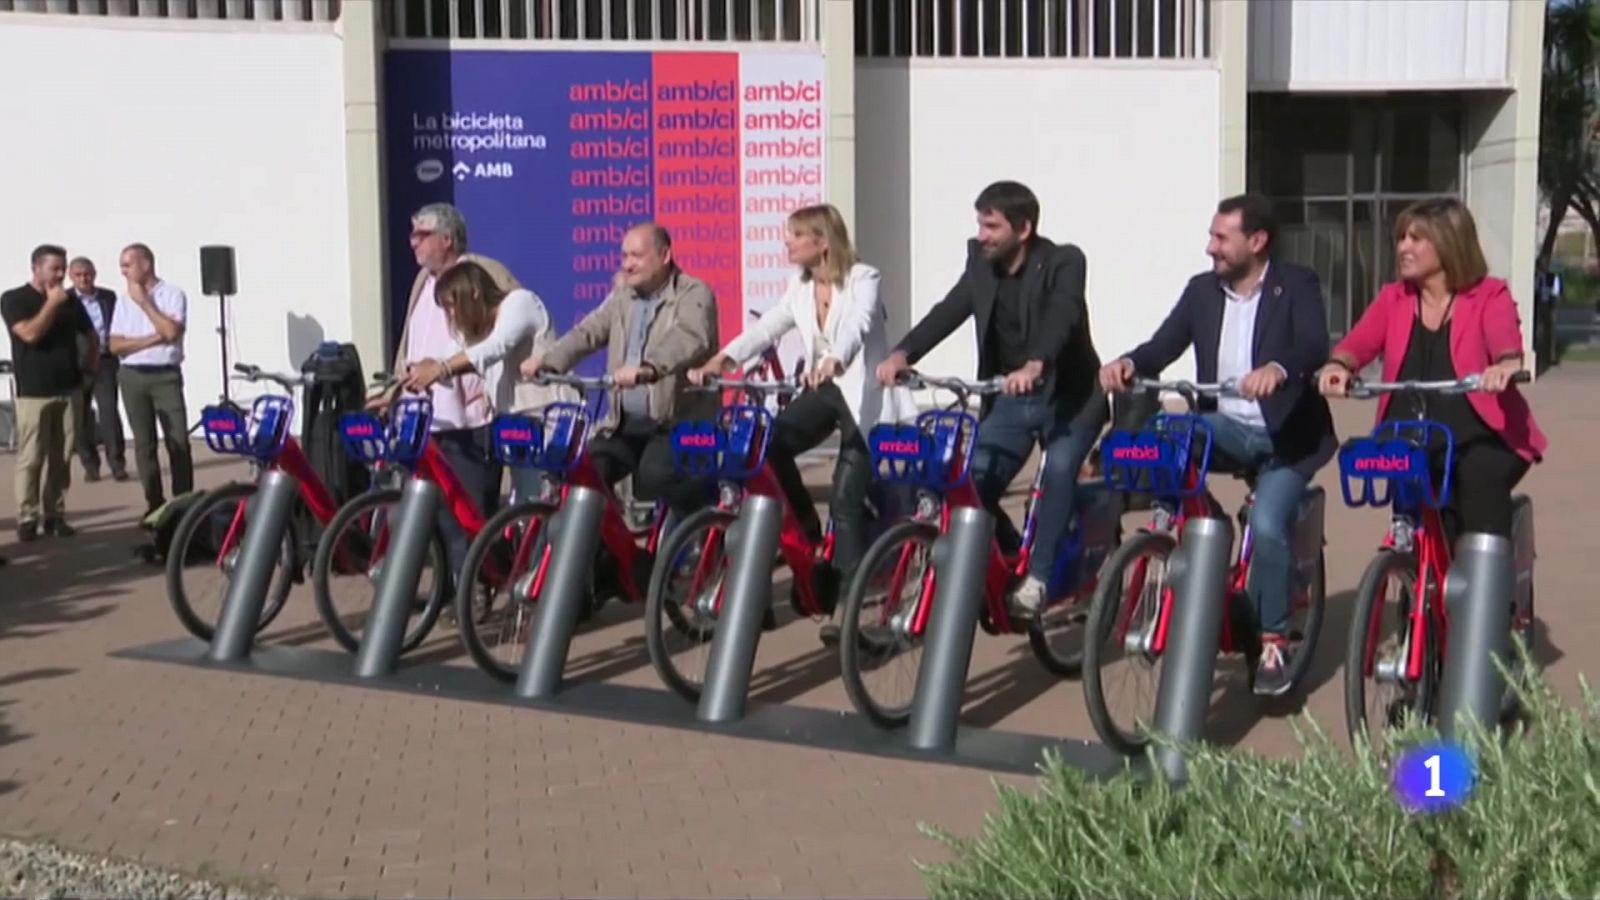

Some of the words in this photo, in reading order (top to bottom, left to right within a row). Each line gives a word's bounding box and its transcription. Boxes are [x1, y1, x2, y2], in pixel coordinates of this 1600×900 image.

[569, 80, 648, 102] amb/ci
[658, 80, 735, 101] amb/ci
[744, 80, 821, 102] amb/ci
[413, 112, 438, 130] La
[442, 112, 523, 130] bicicleta
[570, 108, 648, 130] amb/ci
[658, 108, 735, 130] amb/ci
[744, 108, 821, 130] amb/ci
[414, 132, 546, 153] metropolitana
[570, 136, 648, 159] amb/ci
[658, 136, 735, 158] amb/ci
[744, 136, 821, 158] amb/ci
[474, 162, 513, 178] AMB
[571, 164, 649, 187] amb/ci
[745, 164, 822, 186] amb/ci
[572, 193, 650, 215] amb/ci
[672, 221, 737, 243] mb/ci
